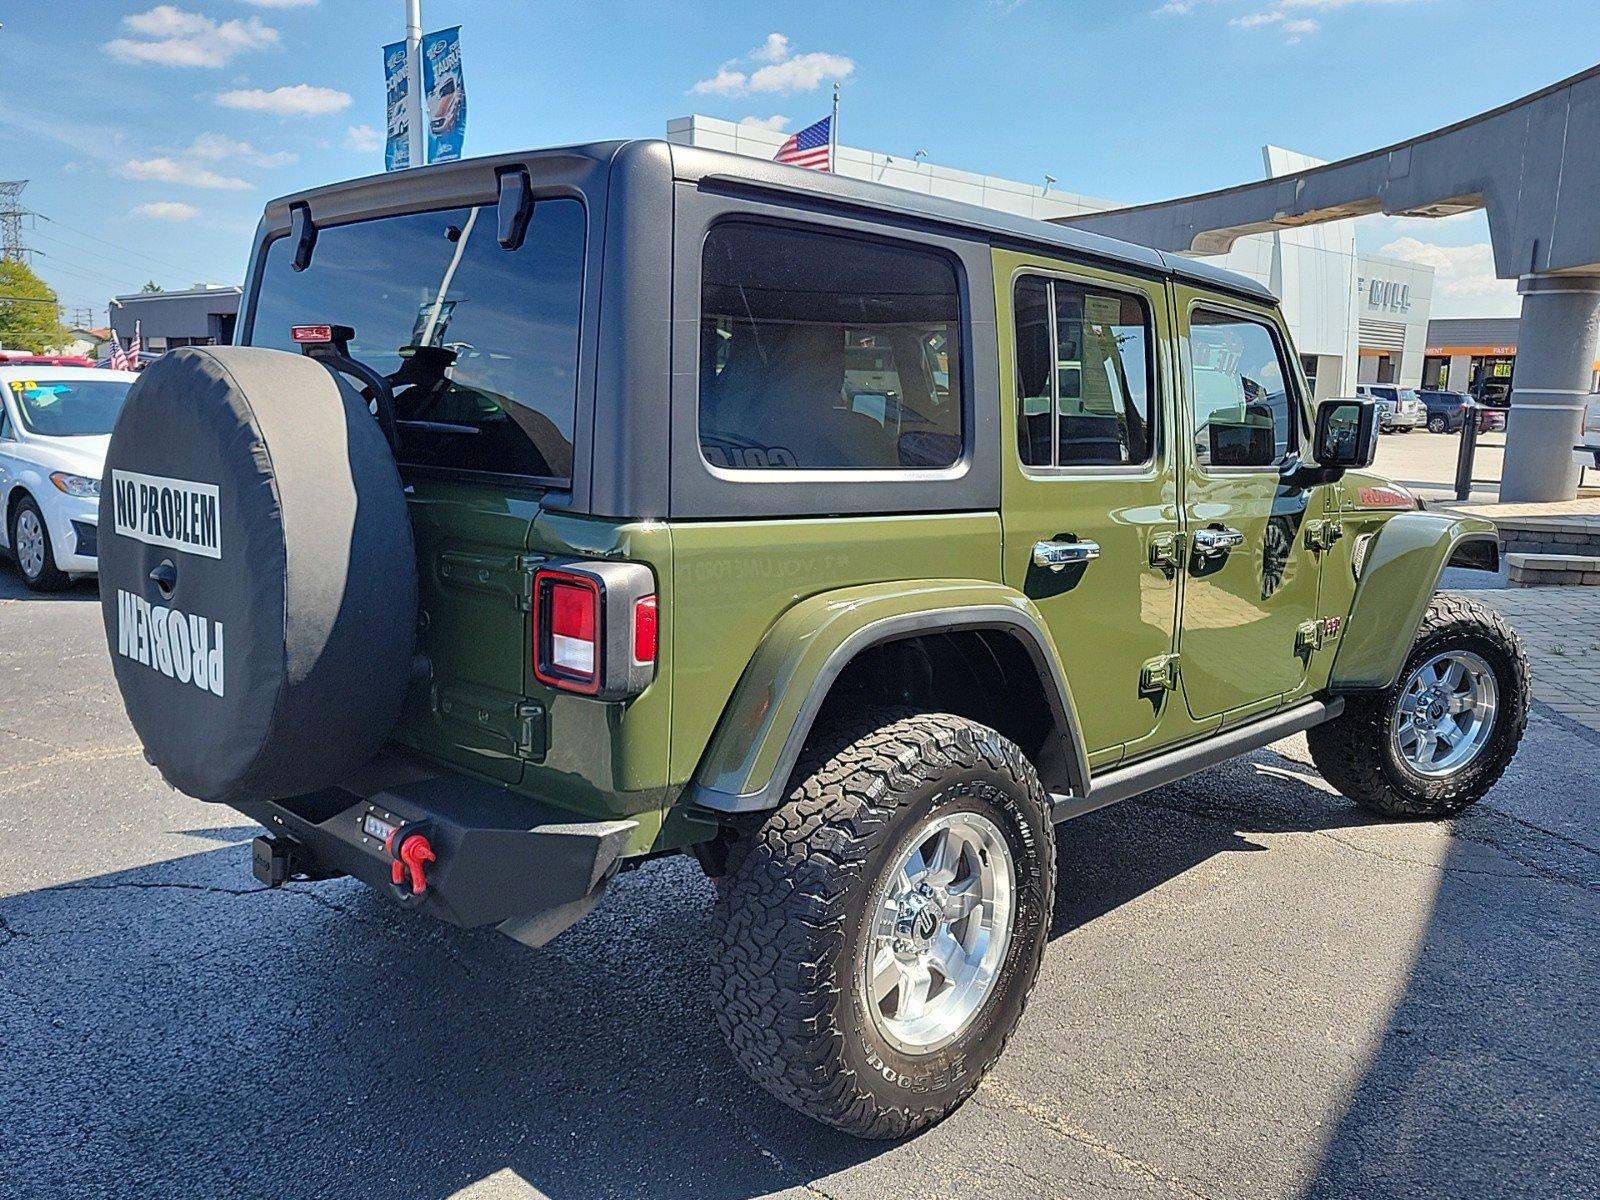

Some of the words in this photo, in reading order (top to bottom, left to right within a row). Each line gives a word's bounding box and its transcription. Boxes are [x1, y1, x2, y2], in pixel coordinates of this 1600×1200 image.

[1369, 279, 1411, 308] MILL
[115, 478, 137, 531] NO
[140, 483, 218, 549] PROBLEM
[118, 589, 225, 698] PROBLEM
